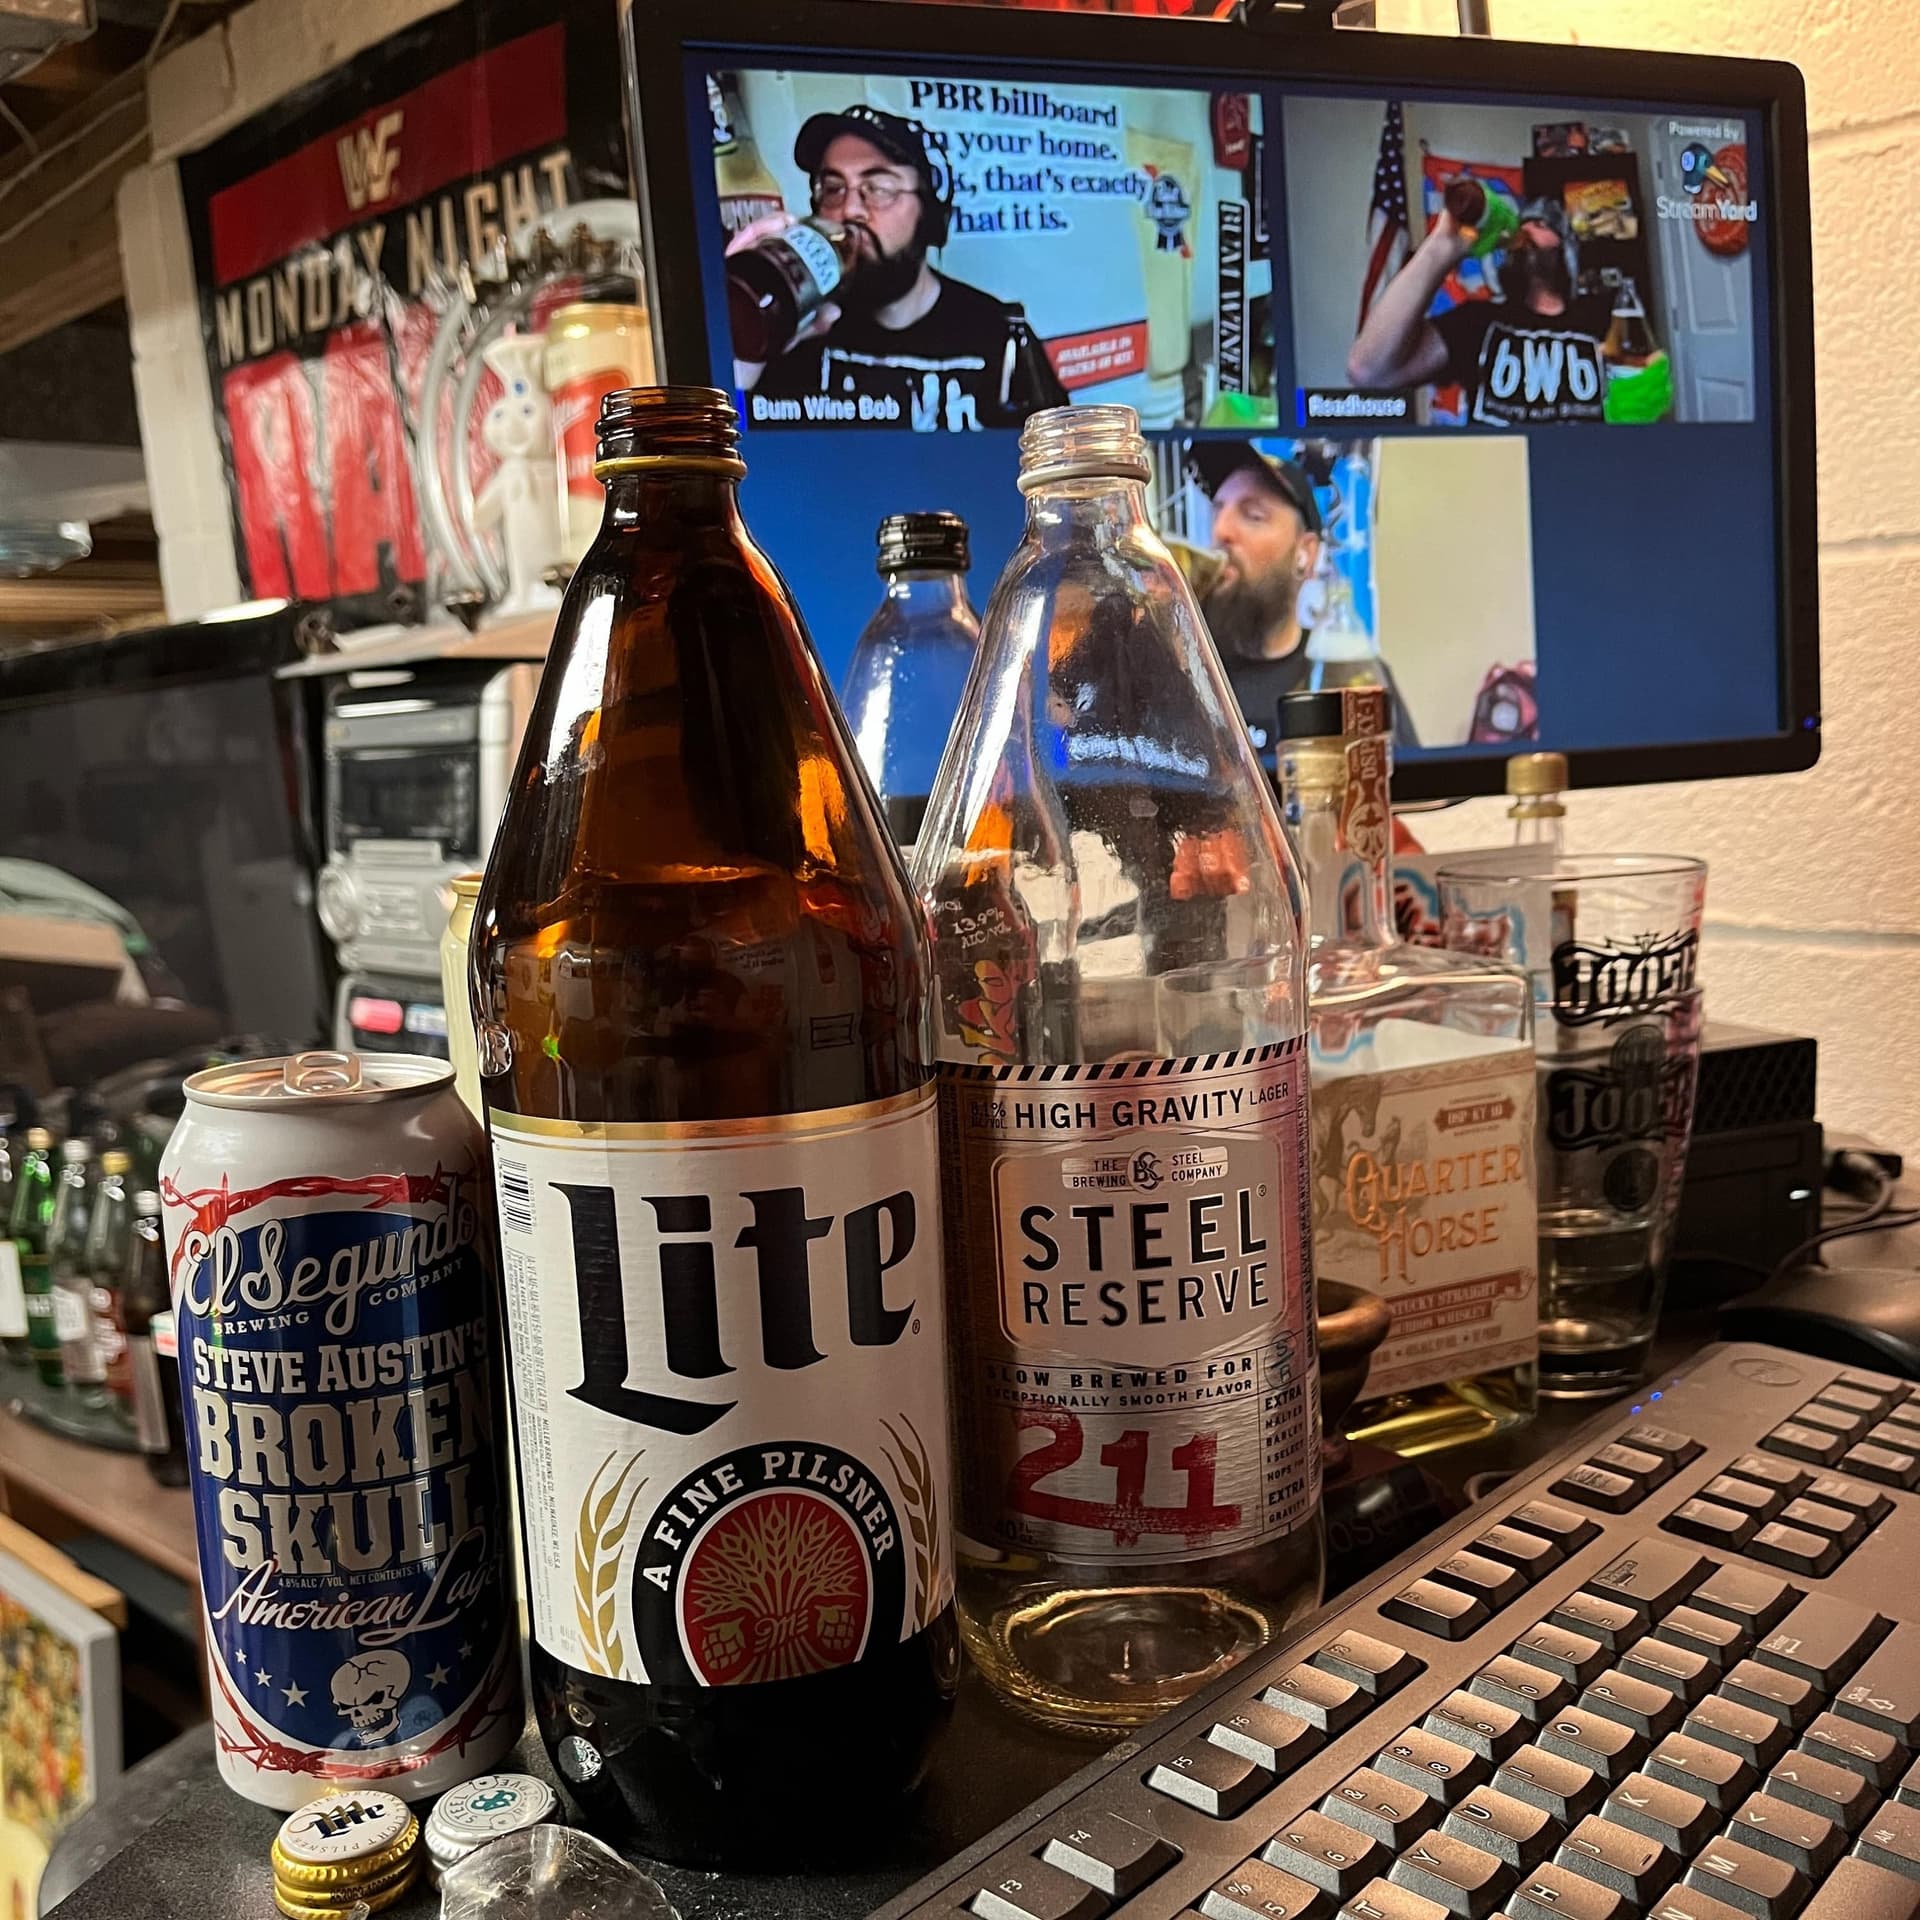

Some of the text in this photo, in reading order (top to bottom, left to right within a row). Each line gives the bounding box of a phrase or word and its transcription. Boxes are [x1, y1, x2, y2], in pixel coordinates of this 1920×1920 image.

[910, 80, 1117, 127] PBR billboard
[957, 132, 1031, 158] your
[1039, 131, 1117, 160] home.
[985, 166, 1064, 193] that's
[1071, 171, 1147, 201] exactly
[952, 203, 1068, 233] hat it is.
[1656, 195, 1758, 222] StreamYard
[215, 150, 573, 366] MONDAY NIGHT
[752, 394, 900, 420] Bum Wine Bob
[1015, 1081, 1289, 1130] HIGH GRAVITY LAGER
[1094, 1152, 1204, 1173] THE STEEL
[1072, 1165, 1223, 1188] BREWING COMPANY
[1346, 1143, 1523, 1230] QUARTER
[1019, 1188, 1268, 1272] STEEL
[183, 1223, 243, 1319] El
[239, 1178, 478, 1336] Segundo
[1378, 1206, 1501, 1285] HORSE
[368, 1257, 464, 1307] COMPANY
[1022, 1261, 1269, 1327] RESERVE
[548, 1181, 918, 1435] Lite
[212, 1310, 311, 1336] BREWING
[192, 1317, 487, 1394] STEVE AUSTIN'S
[985, 1357, 1252, 1388] SLOW BREWED FOR
[985, 1379, 1252, 1408] EXCEPTIONALLY SMOOTH FLAVOR
[1264, 1384, 1303, 1412] EXTRA
[193, 1369, 490, 1487] BROKEN
[1274, 1440, 1304, 1463] SELECT
[1009, 1400, 1243, 1548] 211
[1267, 1464, 1292, 1482] HOPS
[1268, 1478, 1305, 1506] EXTRA
[218, 1463, 487, 1576] SKULL
[653, 1462, 745, 1551] FINE
[763, 1450, 898, 1563] PILSNER
[1269, 1499, 1305, 1524] GRAVITY
[212, 1557, 415, 1631] American
[357, 1524, 497, 1647] Lage
[278, 1576, 300, 1589] 4.8%
[327, 1575, 344, 1588] VOL
[350, 1574, 367, 1587] NET
[647, 1563, 672, 1592] A
[1594, 1687, 1617, 1699] P
[1230, 1715, 1250, 1728] F6
[1172, 1755, 1193, 1770] F5
[1429, 1762, 1450, 1773] 8
[1659, 1754, 1687, 1765] L
[1379, 1804, 1399, 1816] 7
[1463, 1803, 1491, 1820] U
[1619, 1792, 1649, 1808] K
[1068, 1829, 1092, 1844] F4
[1575, 1838, 1601, 1854] J
[1325, 1851, 1346, 1862] 6
[1412, 1847, 1441, 1866] Y
[1704, 1853, 1739, 1875] M
[999, 1879, 1023, 1895] F3
[1226, 1881, 1286, 1916] % 5
[1528, 1883, 1561, 1902] H
[1353, 1900, 1384, 1918] T
[1661, 1906, 1695, 1920] N
